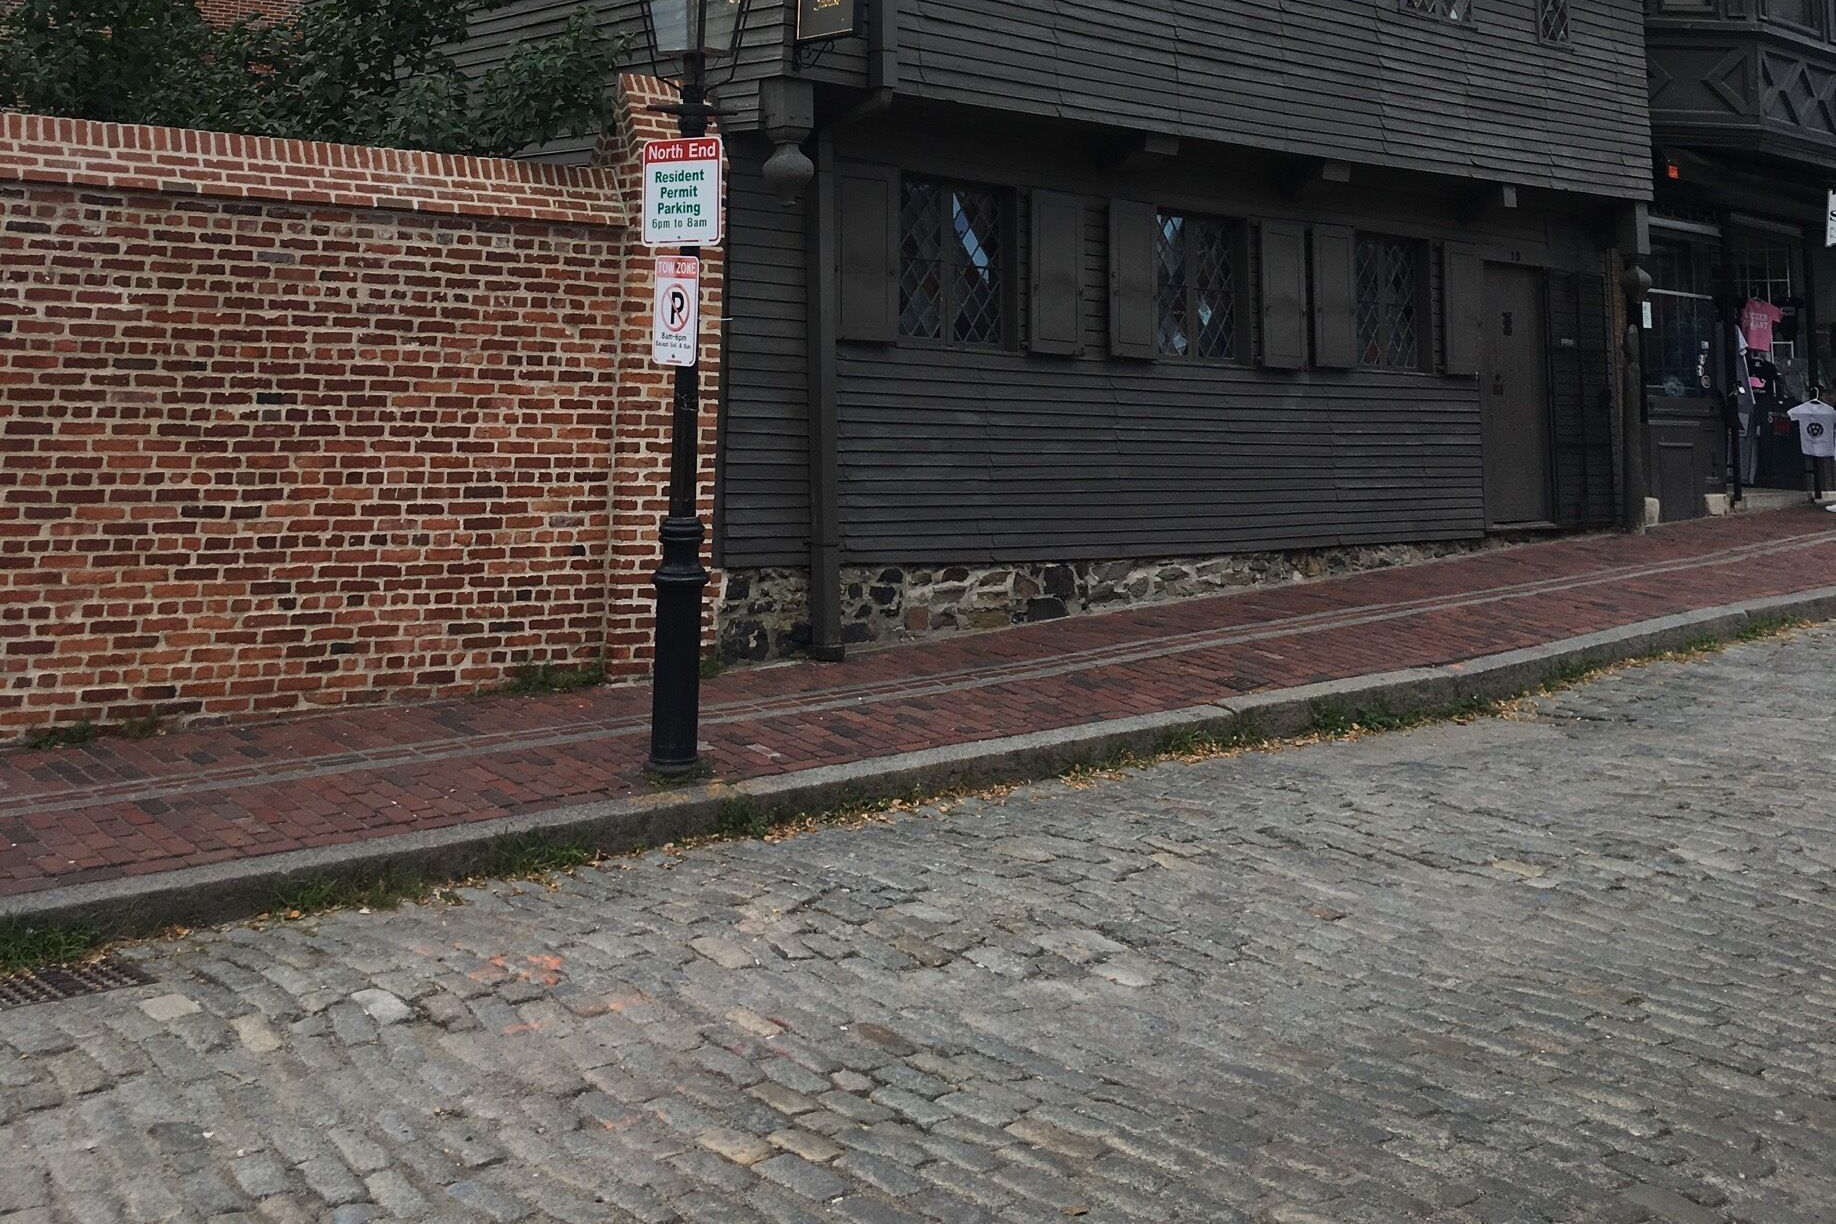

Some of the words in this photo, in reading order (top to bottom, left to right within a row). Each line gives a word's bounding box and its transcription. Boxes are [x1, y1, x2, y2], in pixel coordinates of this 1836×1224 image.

[648, 143, 684, 160] North
[688, 142, 716, 158] End
[655, 169, 705, 184] Resident
[660, 185, 698, 199] Permit
[657, 201, 701, 216] Parking
[652, 218, 671, 230] 6pm
[674, 218, 683, 228] to
[687, 217, 707, 228] 8am
[658, 262, 675, 274] TOW
[676, 262, 697, 275] ZONE
